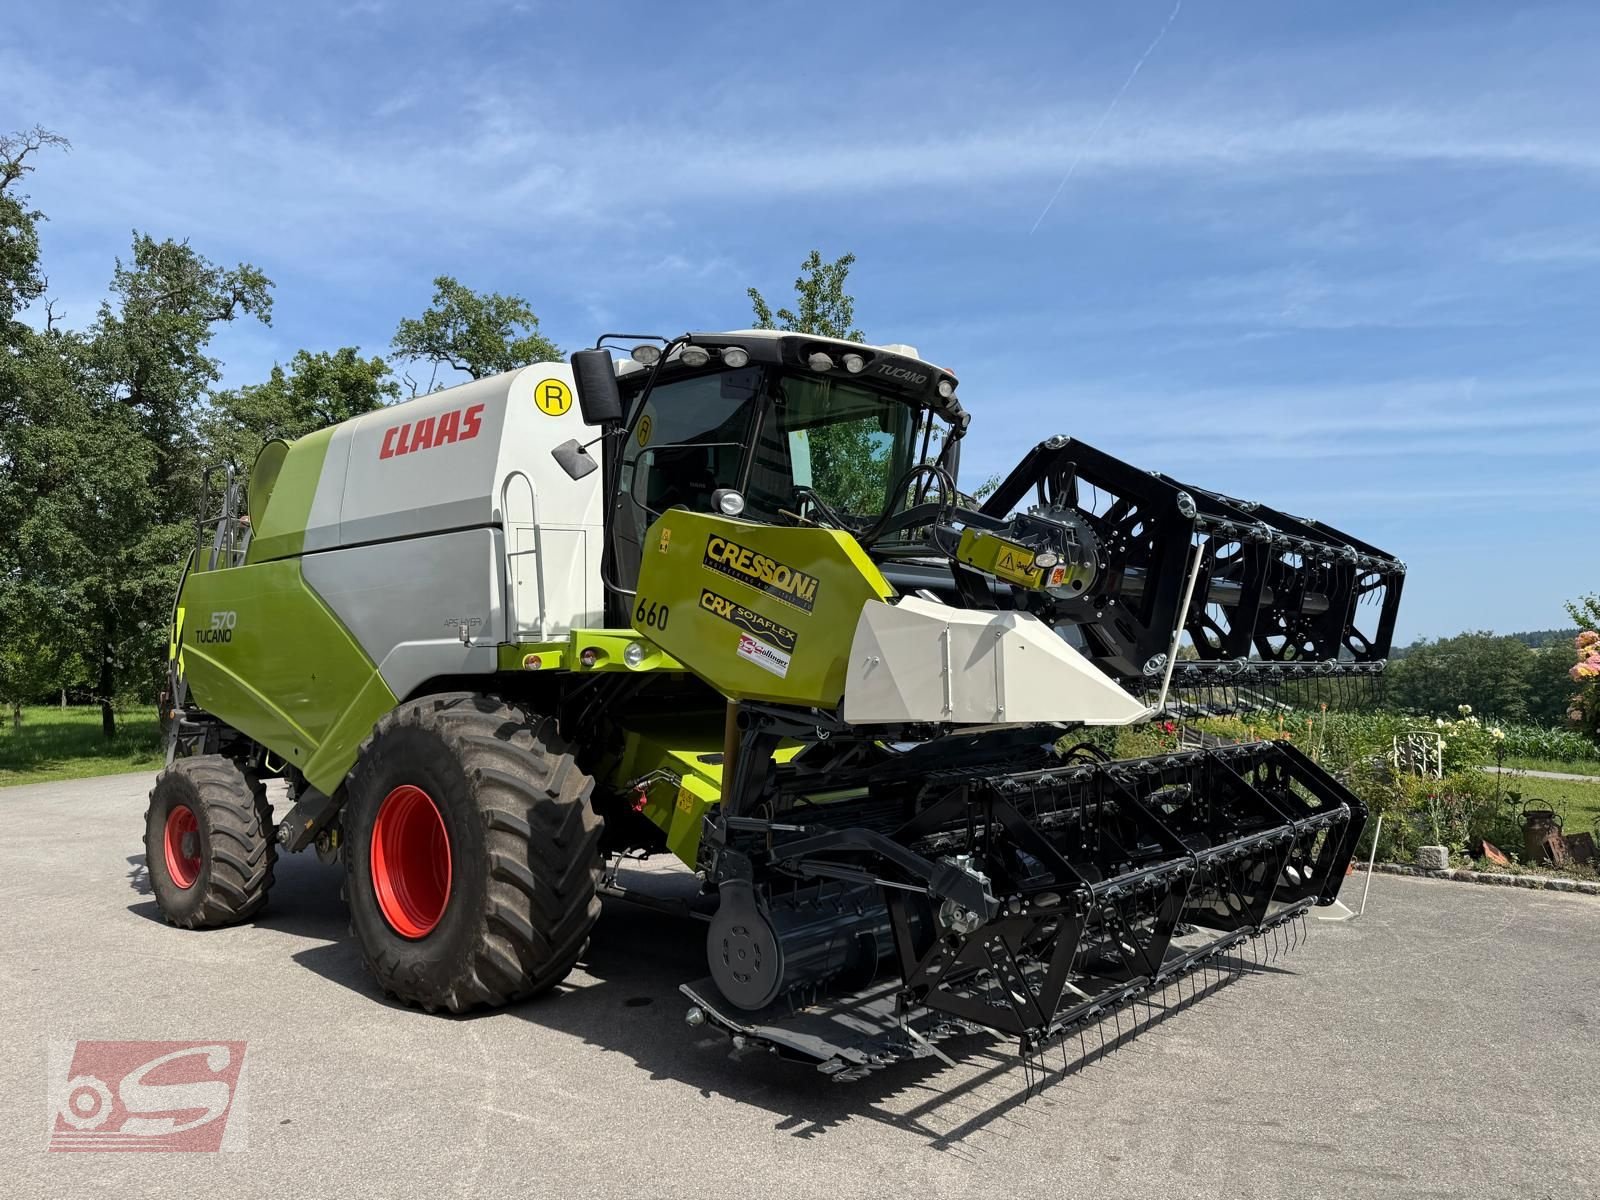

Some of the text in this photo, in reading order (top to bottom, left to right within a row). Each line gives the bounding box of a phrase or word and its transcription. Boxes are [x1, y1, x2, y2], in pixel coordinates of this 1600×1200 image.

[878, 364, 928, 385] TUCANO
[545, 385, 563, 409] R
[379, 403, 485, 460] CLAAS
[211, 611, 237, 630] 570
[636, 598, 669, 631] 660
[701, 592, 736, 619] CRX
[736, 607, 795, 641] SOJAFLEX
[196, 629, 232, 643] TUCANO
